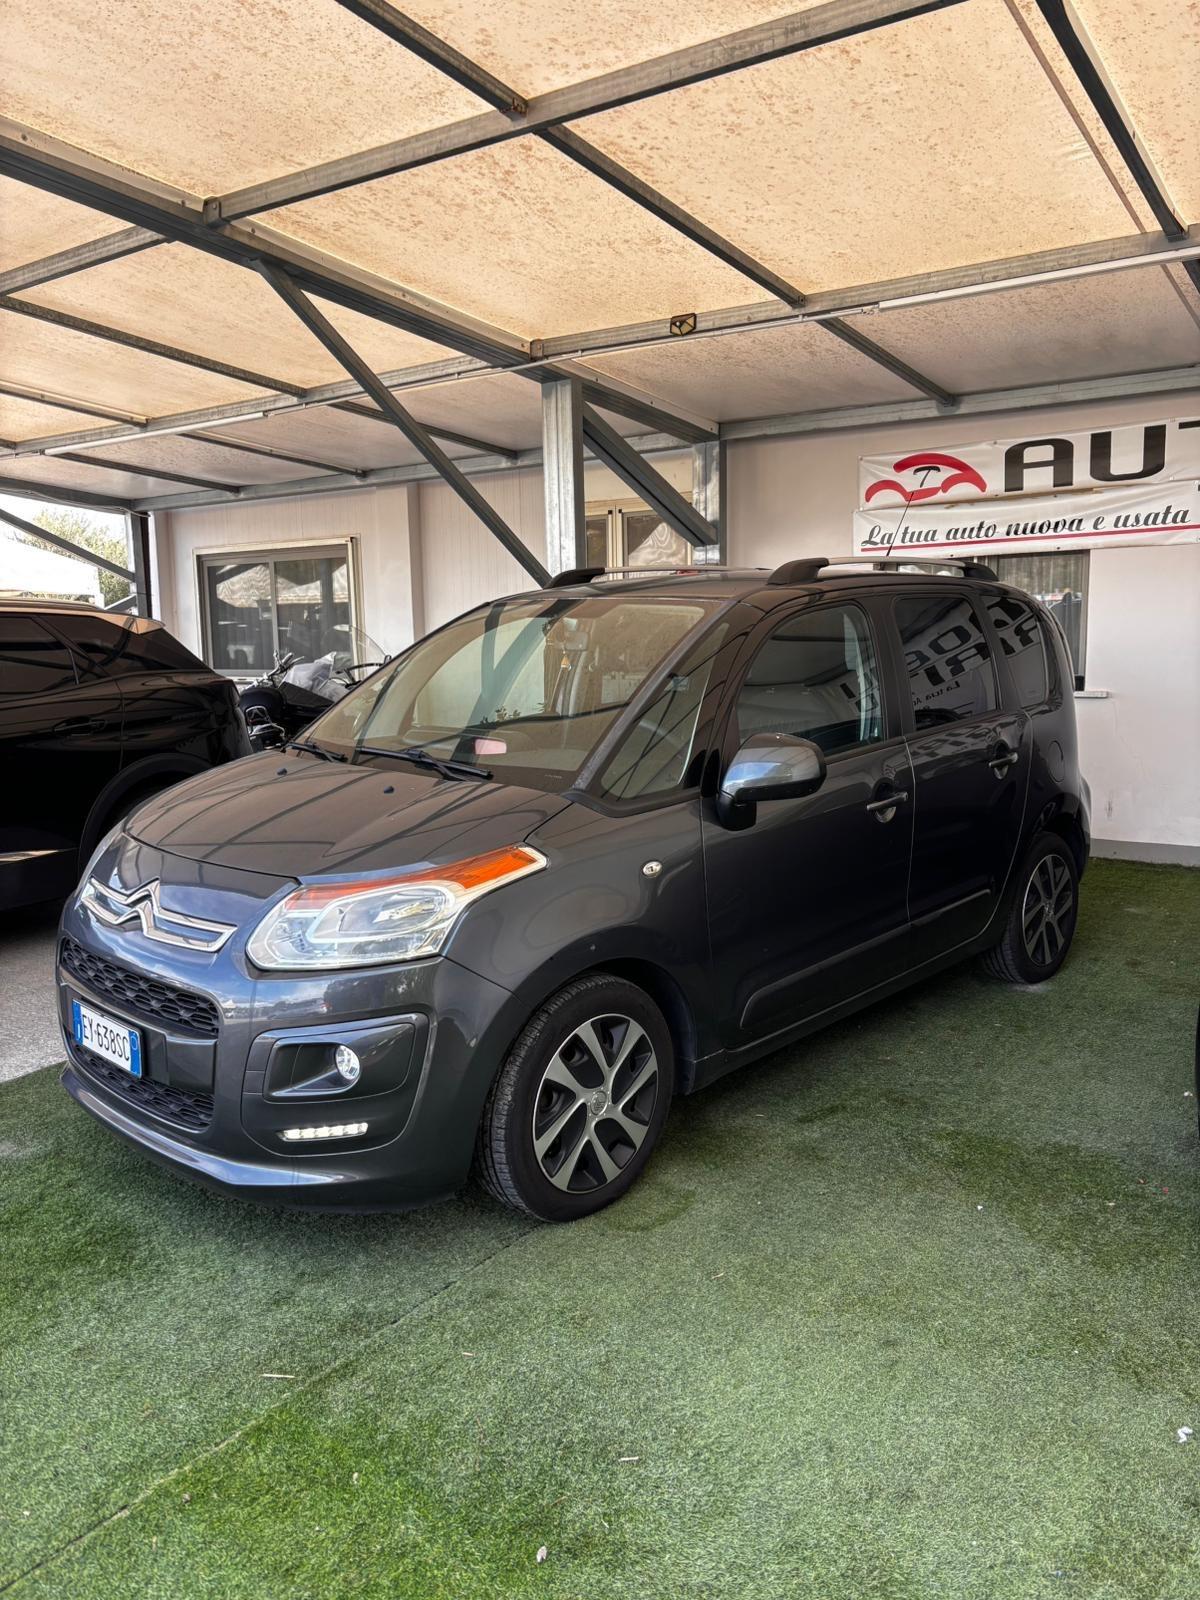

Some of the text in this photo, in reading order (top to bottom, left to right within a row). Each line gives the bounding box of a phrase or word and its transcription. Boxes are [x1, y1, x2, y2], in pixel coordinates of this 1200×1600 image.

[1004, 421, 1200, 493] AU
[861, 505, 1191, 547] La tua auto nuova e usata
